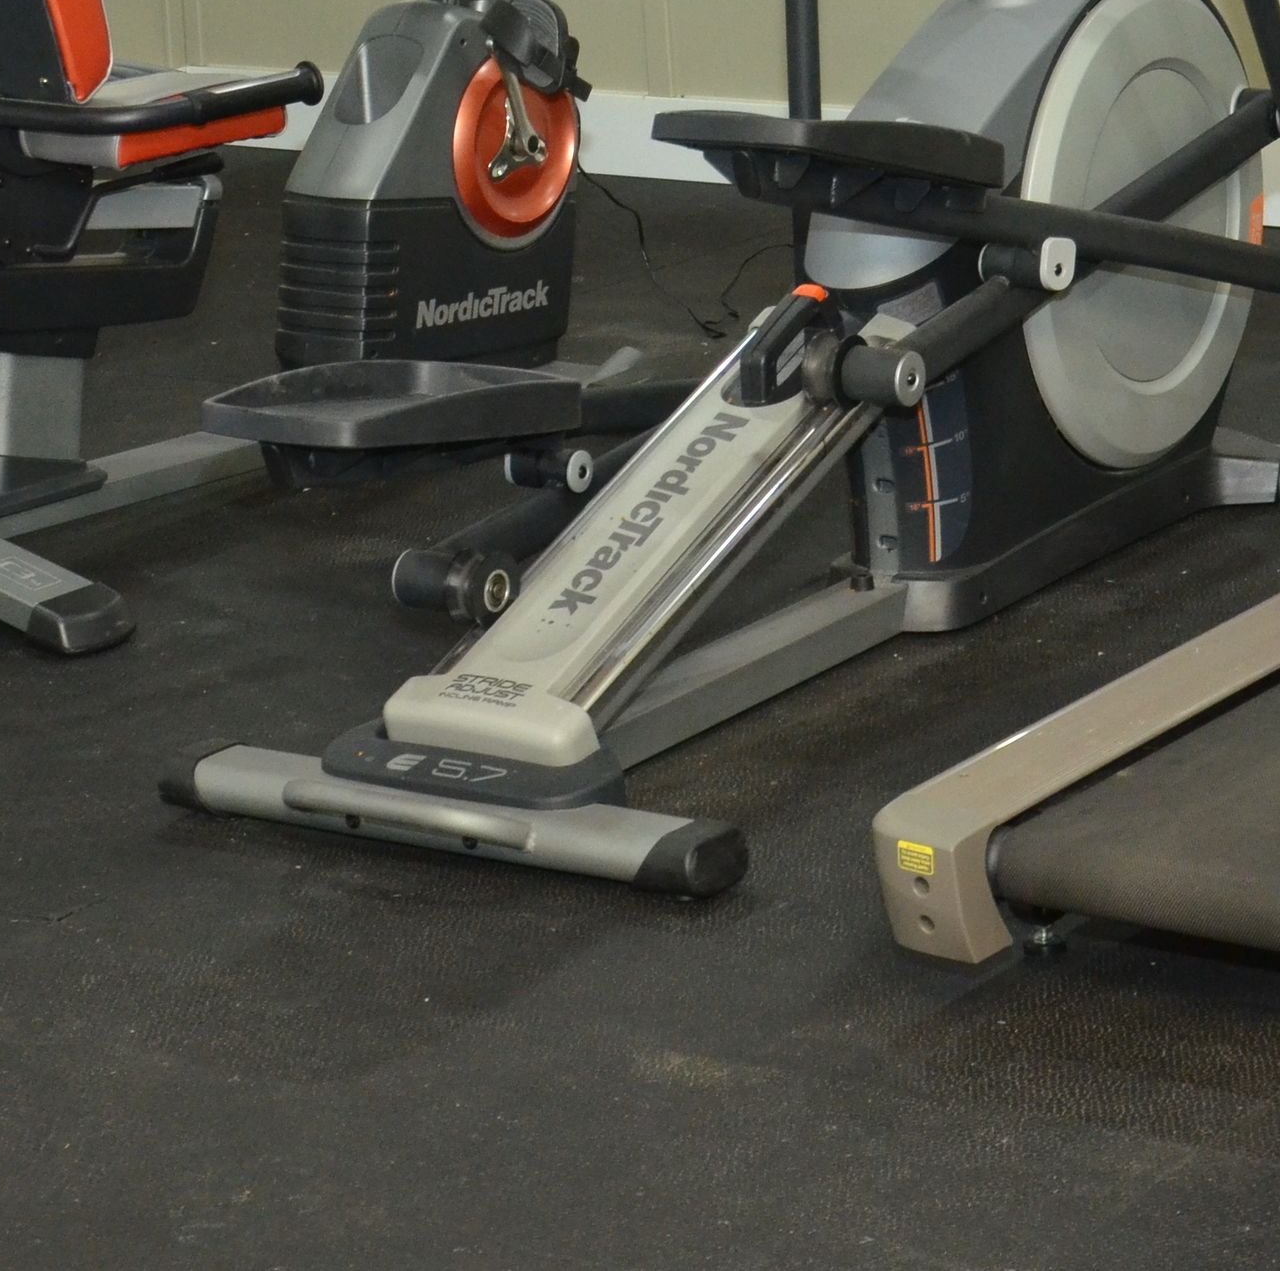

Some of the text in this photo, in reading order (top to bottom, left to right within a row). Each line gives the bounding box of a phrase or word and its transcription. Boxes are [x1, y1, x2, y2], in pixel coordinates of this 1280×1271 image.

[415, 279, 550, 329] NordicTrack
[548, 412, 750, 616] NordicTrack
[445, 683, 525, 700] ADJUST
[452, 673, 534, 693] STRIDE
[431, 759, 508, 783] 5.7
